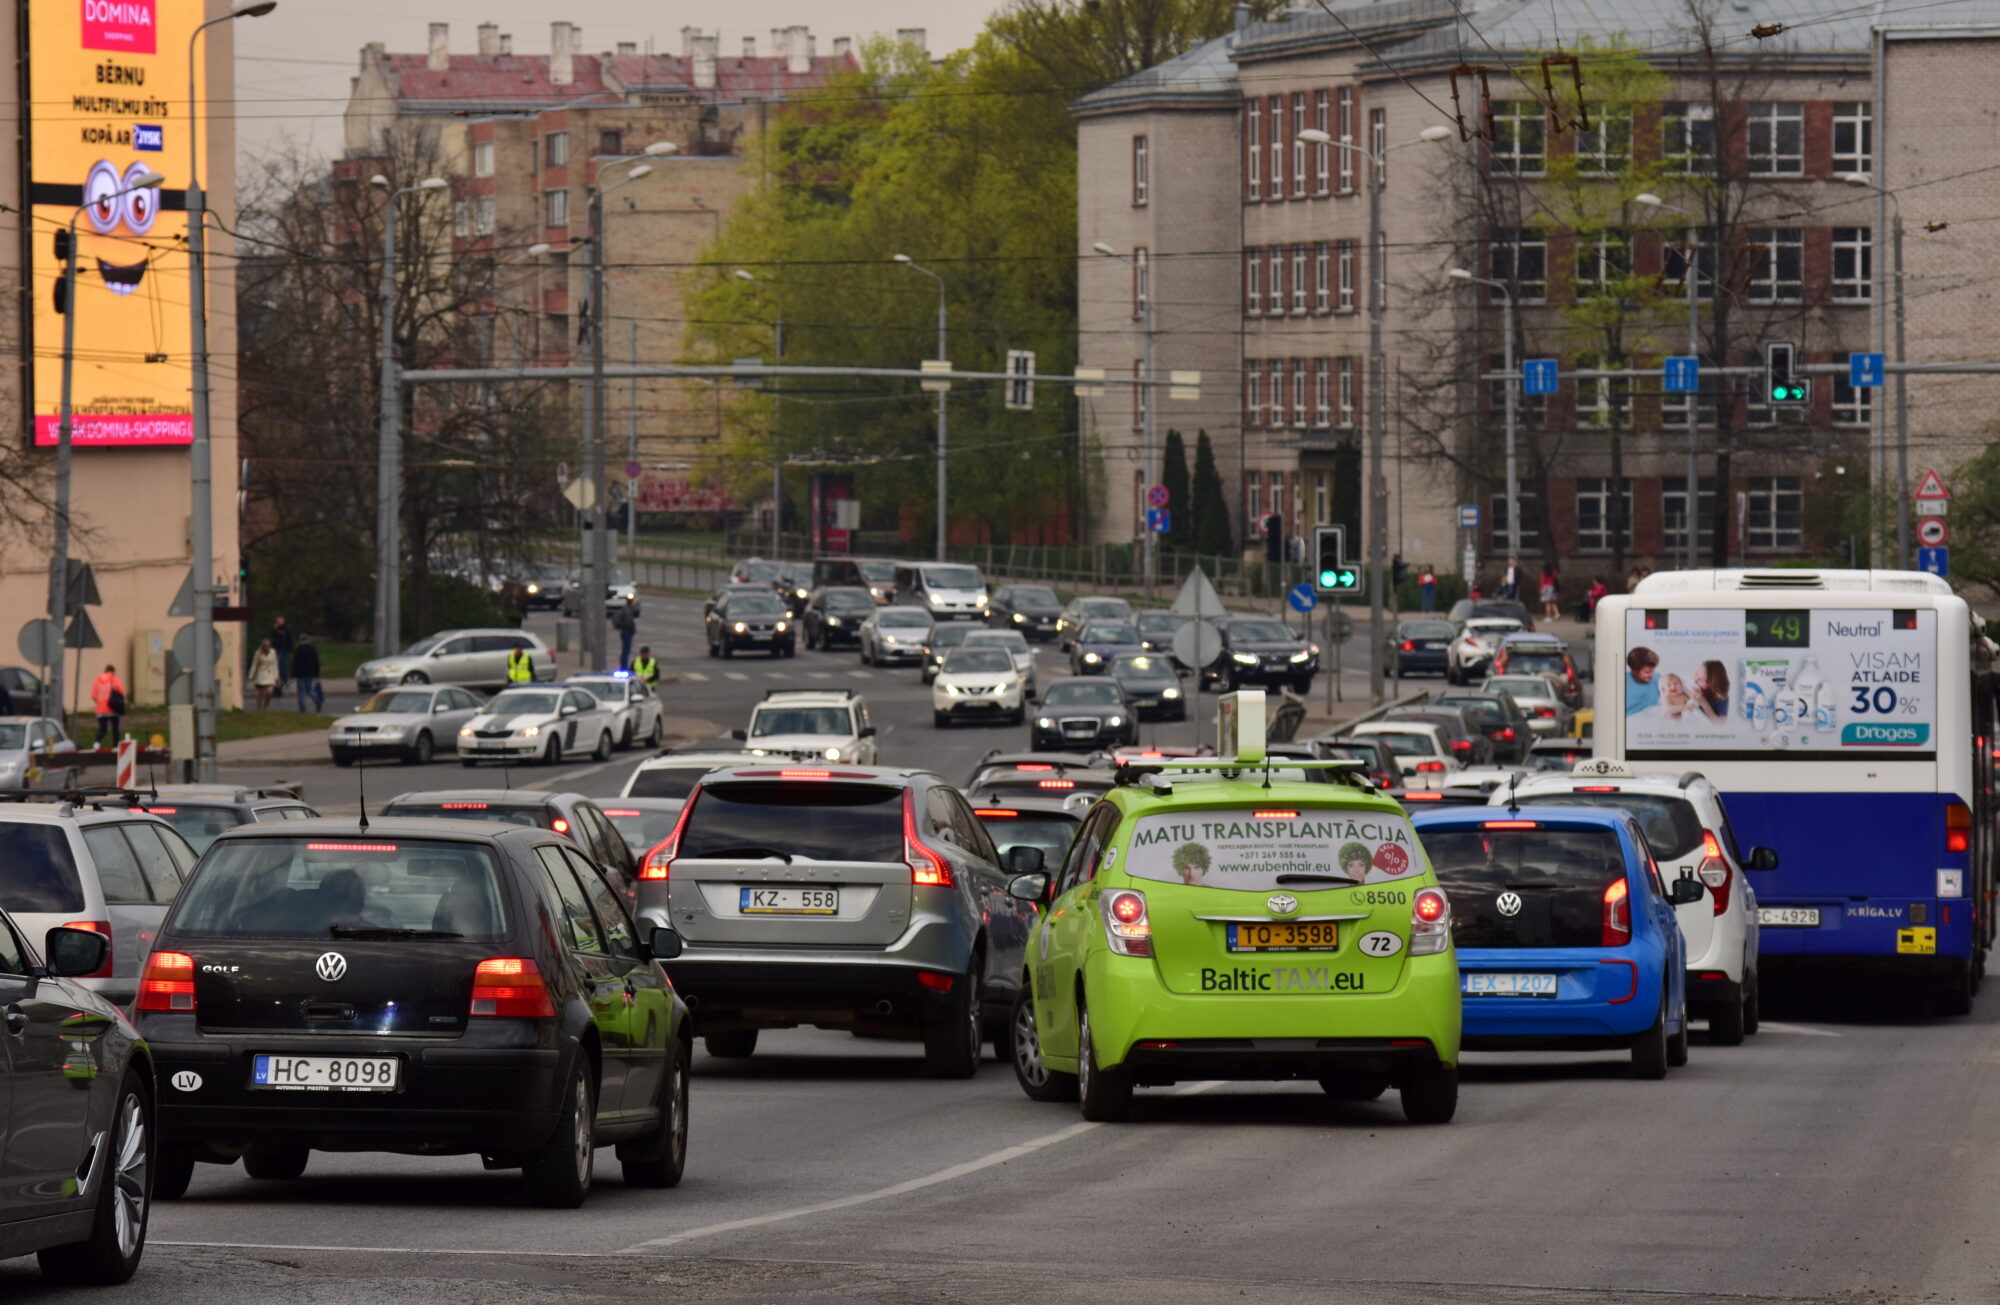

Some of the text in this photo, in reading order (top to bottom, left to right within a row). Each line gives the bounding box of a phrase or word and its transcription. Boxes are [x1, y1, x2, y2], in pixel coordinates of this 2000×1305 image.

[85, 0, 151, 26] DOMINA
[115, 128, 131, 145] AR
[1770, 616, 1800, 640] 49
[1828, 620, 1881, 637] Neutral
[1850, 651, 1921, 669] VISAM
[1851, 671, 1921, 683] ATLAIDE
[1856, 726, 1917, 742] Drogas
[1134, 819, 1409, 848] MATU TRANSPLANTĀCIJA
[1240, 851, 1306, 859] +371 269 555 66
[1219, 861, 1331, 873] www.rubenhair.eu
[1366, 891, 1407, 905] 8500
[1242, 925, 1334, 944] TQ-3598
[1371, 937, 1391, 951] 72
[202, 965, 240, 974] GOLF
[1201, 968, 1365, 991] BalticTAXI.eu
[1472, 976, 1553, 991] EX-1207
[274, 1059, 392, 1083] HC-8098
[178, 1075, 196, 1088] LV
